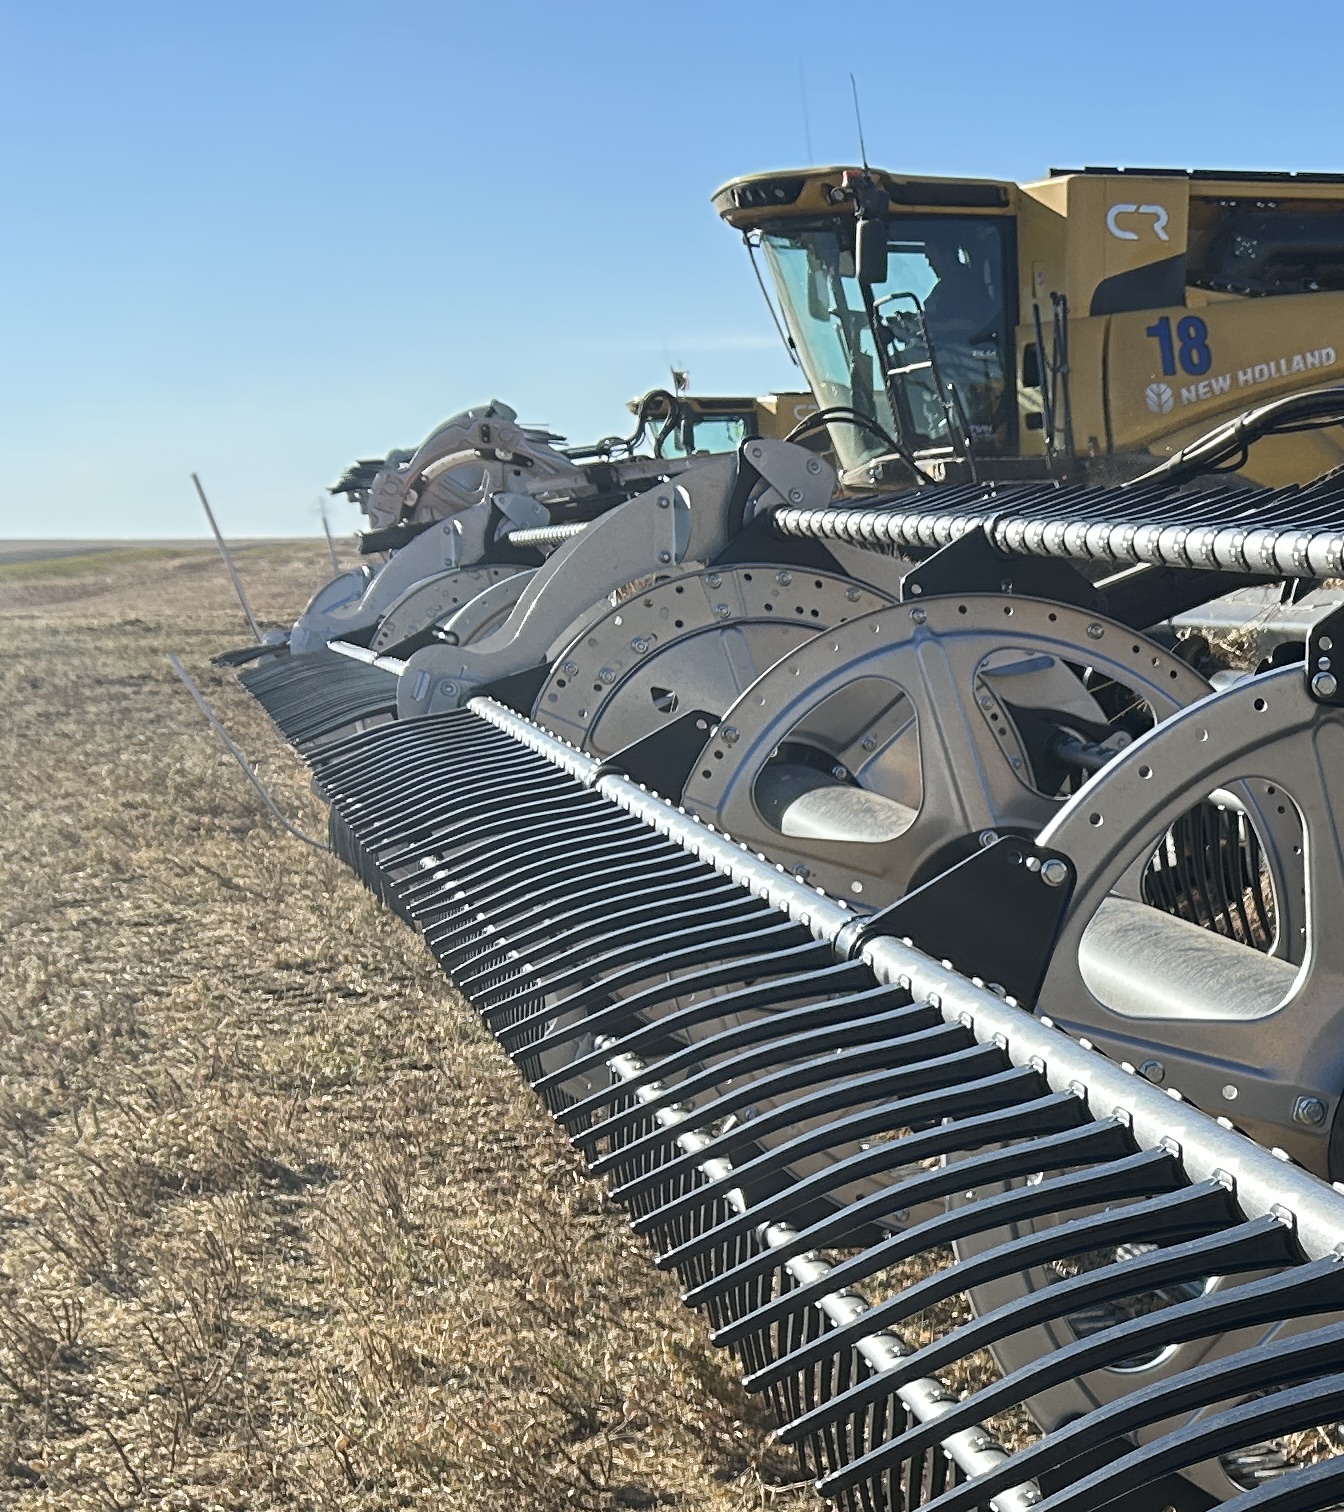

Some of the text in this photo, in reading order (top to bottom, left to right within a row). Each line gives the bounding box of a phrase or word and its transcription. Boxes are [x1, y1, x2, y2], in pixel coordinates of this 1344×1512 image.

[1106, 203, 1170, 241] CR
[1145, 315, 1213, 376] 18
[1180, 346, 1337, 405] NEW HOLLAND
